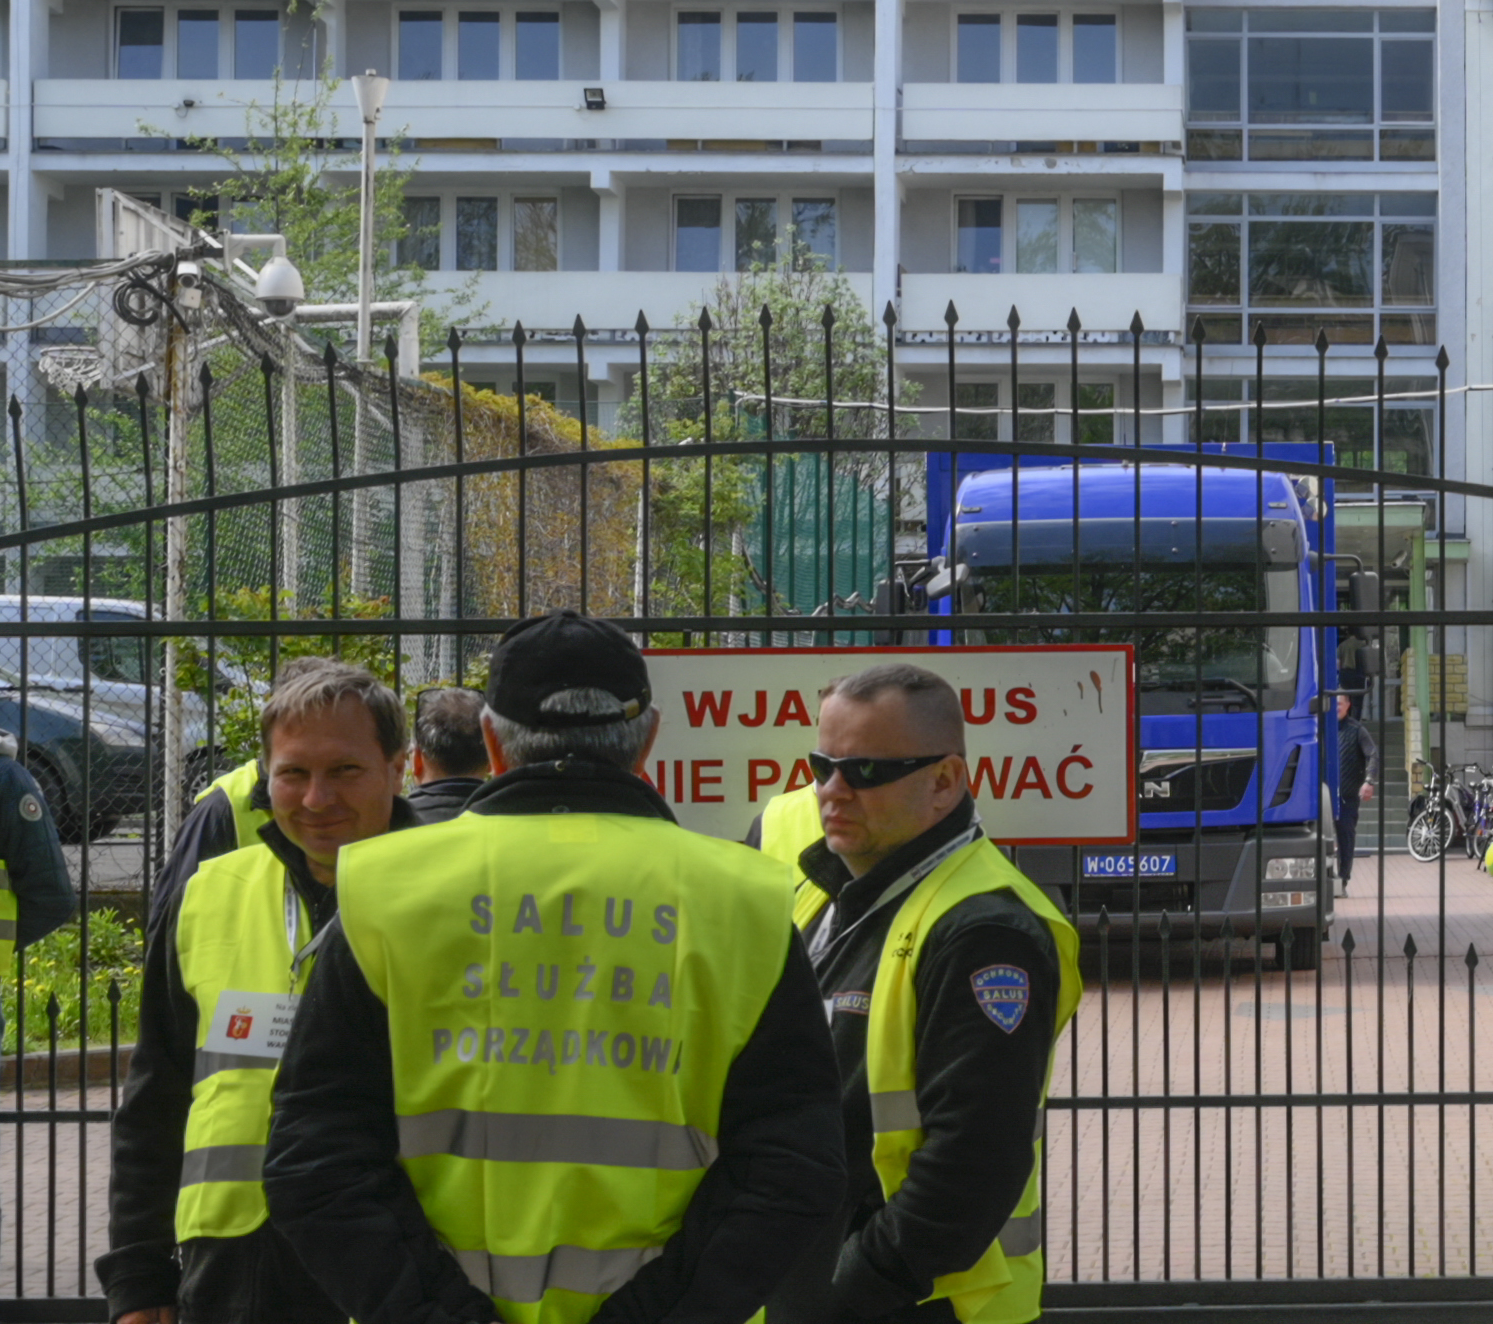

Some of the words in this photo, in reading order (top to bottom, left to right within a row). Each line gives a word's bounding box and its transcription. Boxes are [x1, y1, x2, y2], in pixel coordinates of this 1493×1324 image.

[682, 689, 819, 728] WJA
[960, 687, 1038, 726] US
[748, 744, 1095, 803] PAWAĆ
[469, 893, 677, 945] SALUS
[462, 955, 673, 1009] SŁUŻBA
[983, 989, 1024, 1000] SALUS
